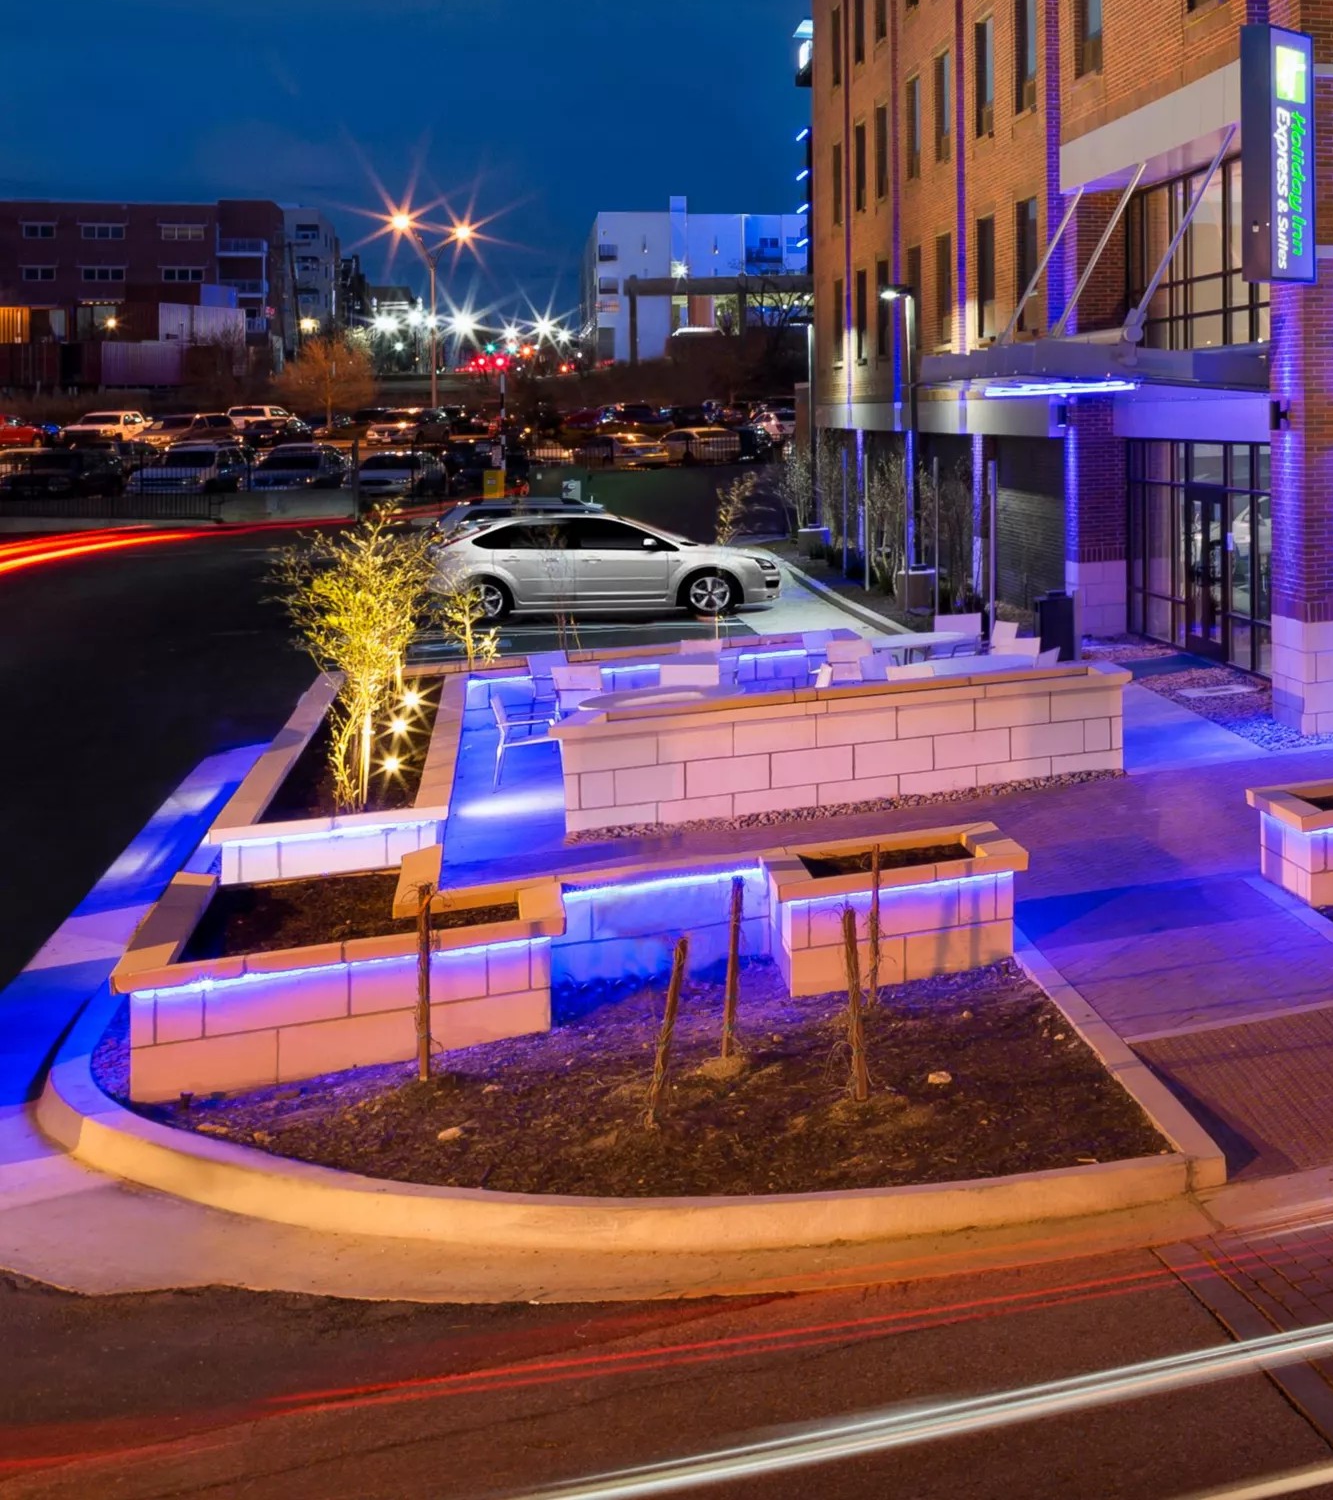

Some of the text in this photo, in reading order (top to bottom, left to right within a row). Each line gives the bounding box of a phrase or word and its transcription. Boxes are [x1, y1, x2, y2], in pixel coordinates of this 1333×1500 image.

[1274, 106, 1291, 270] Express & Suites
[1289, 110, 1306, 213] Holiday
[1292, 218, 1307, 256] Inn
